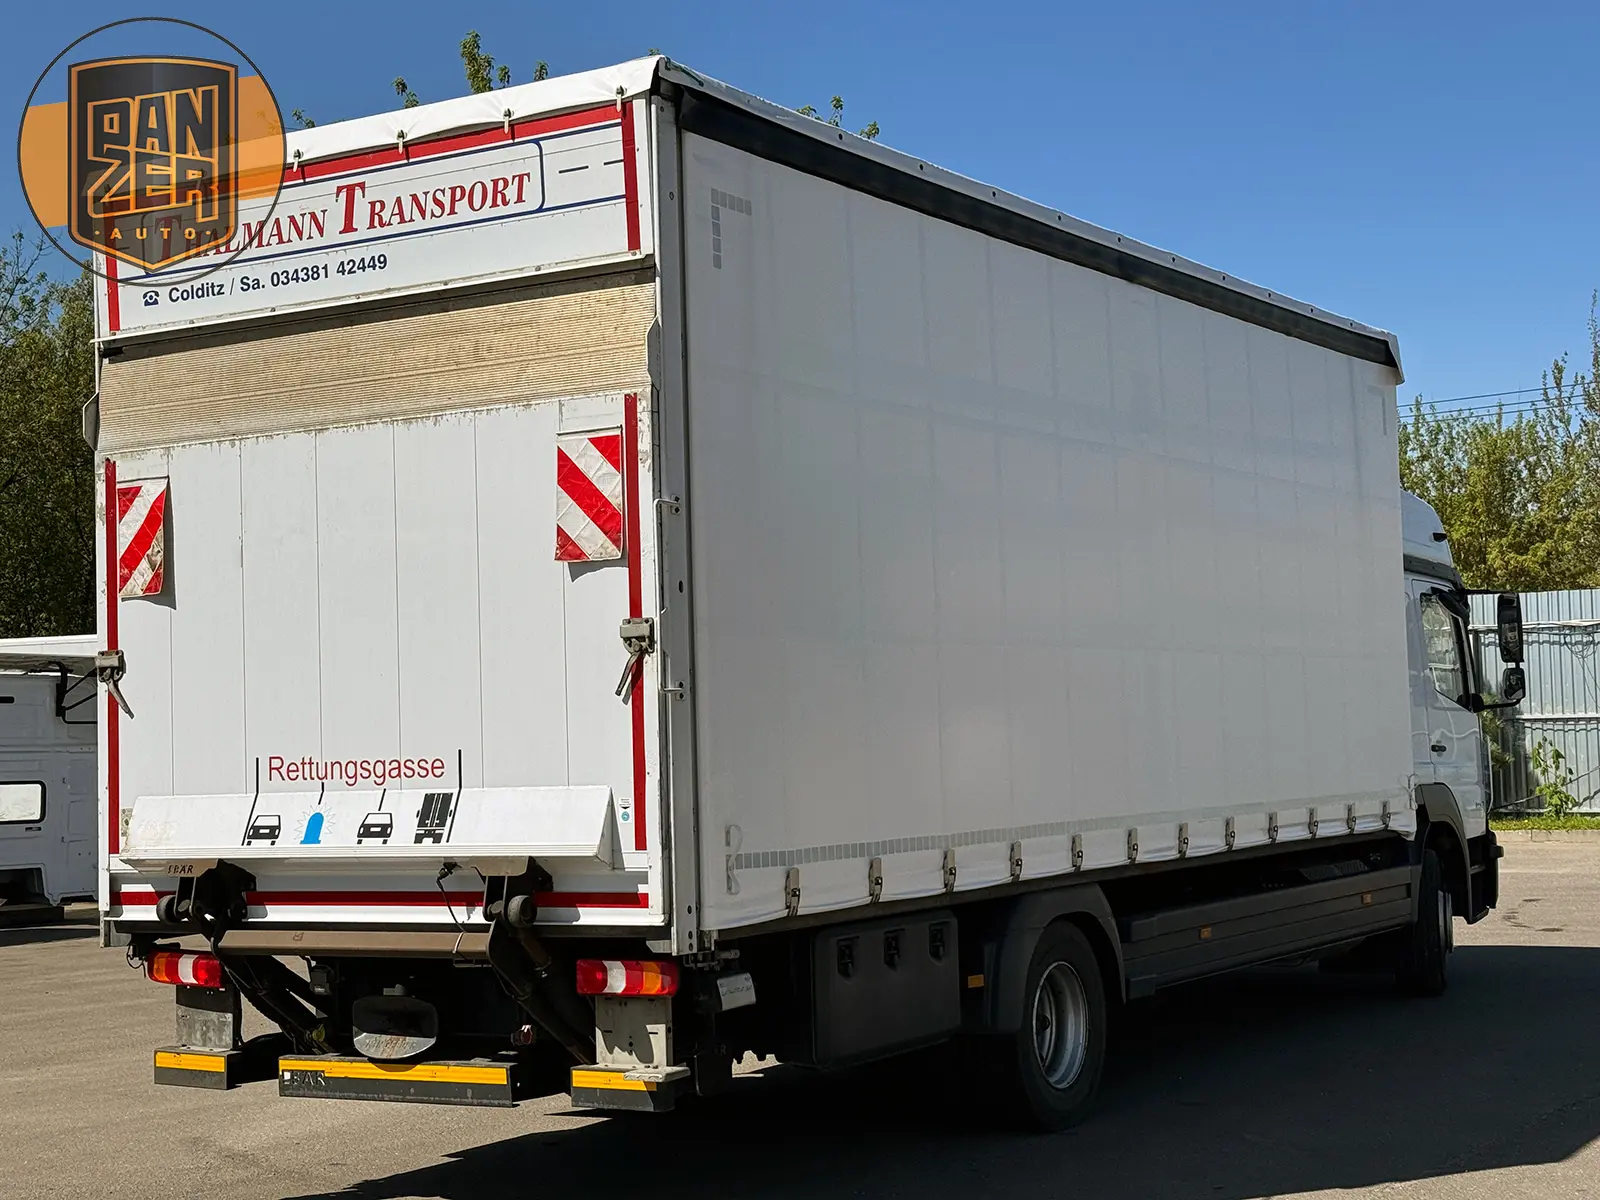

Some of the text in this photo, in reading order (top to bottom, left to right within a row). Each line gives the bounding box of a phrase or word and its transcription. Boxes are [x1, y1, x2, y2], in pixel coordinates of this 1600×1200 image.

[335, 172, 531, 235] TRANSPORT
[168, 282, 225, 303] Colditz
[239, 275, 265, 292] Sa.
[270, 263, 329, 287] 034381
[336, 253, 388, 276] 42449
[268, 756, 445, 787] Rettungsgasse
